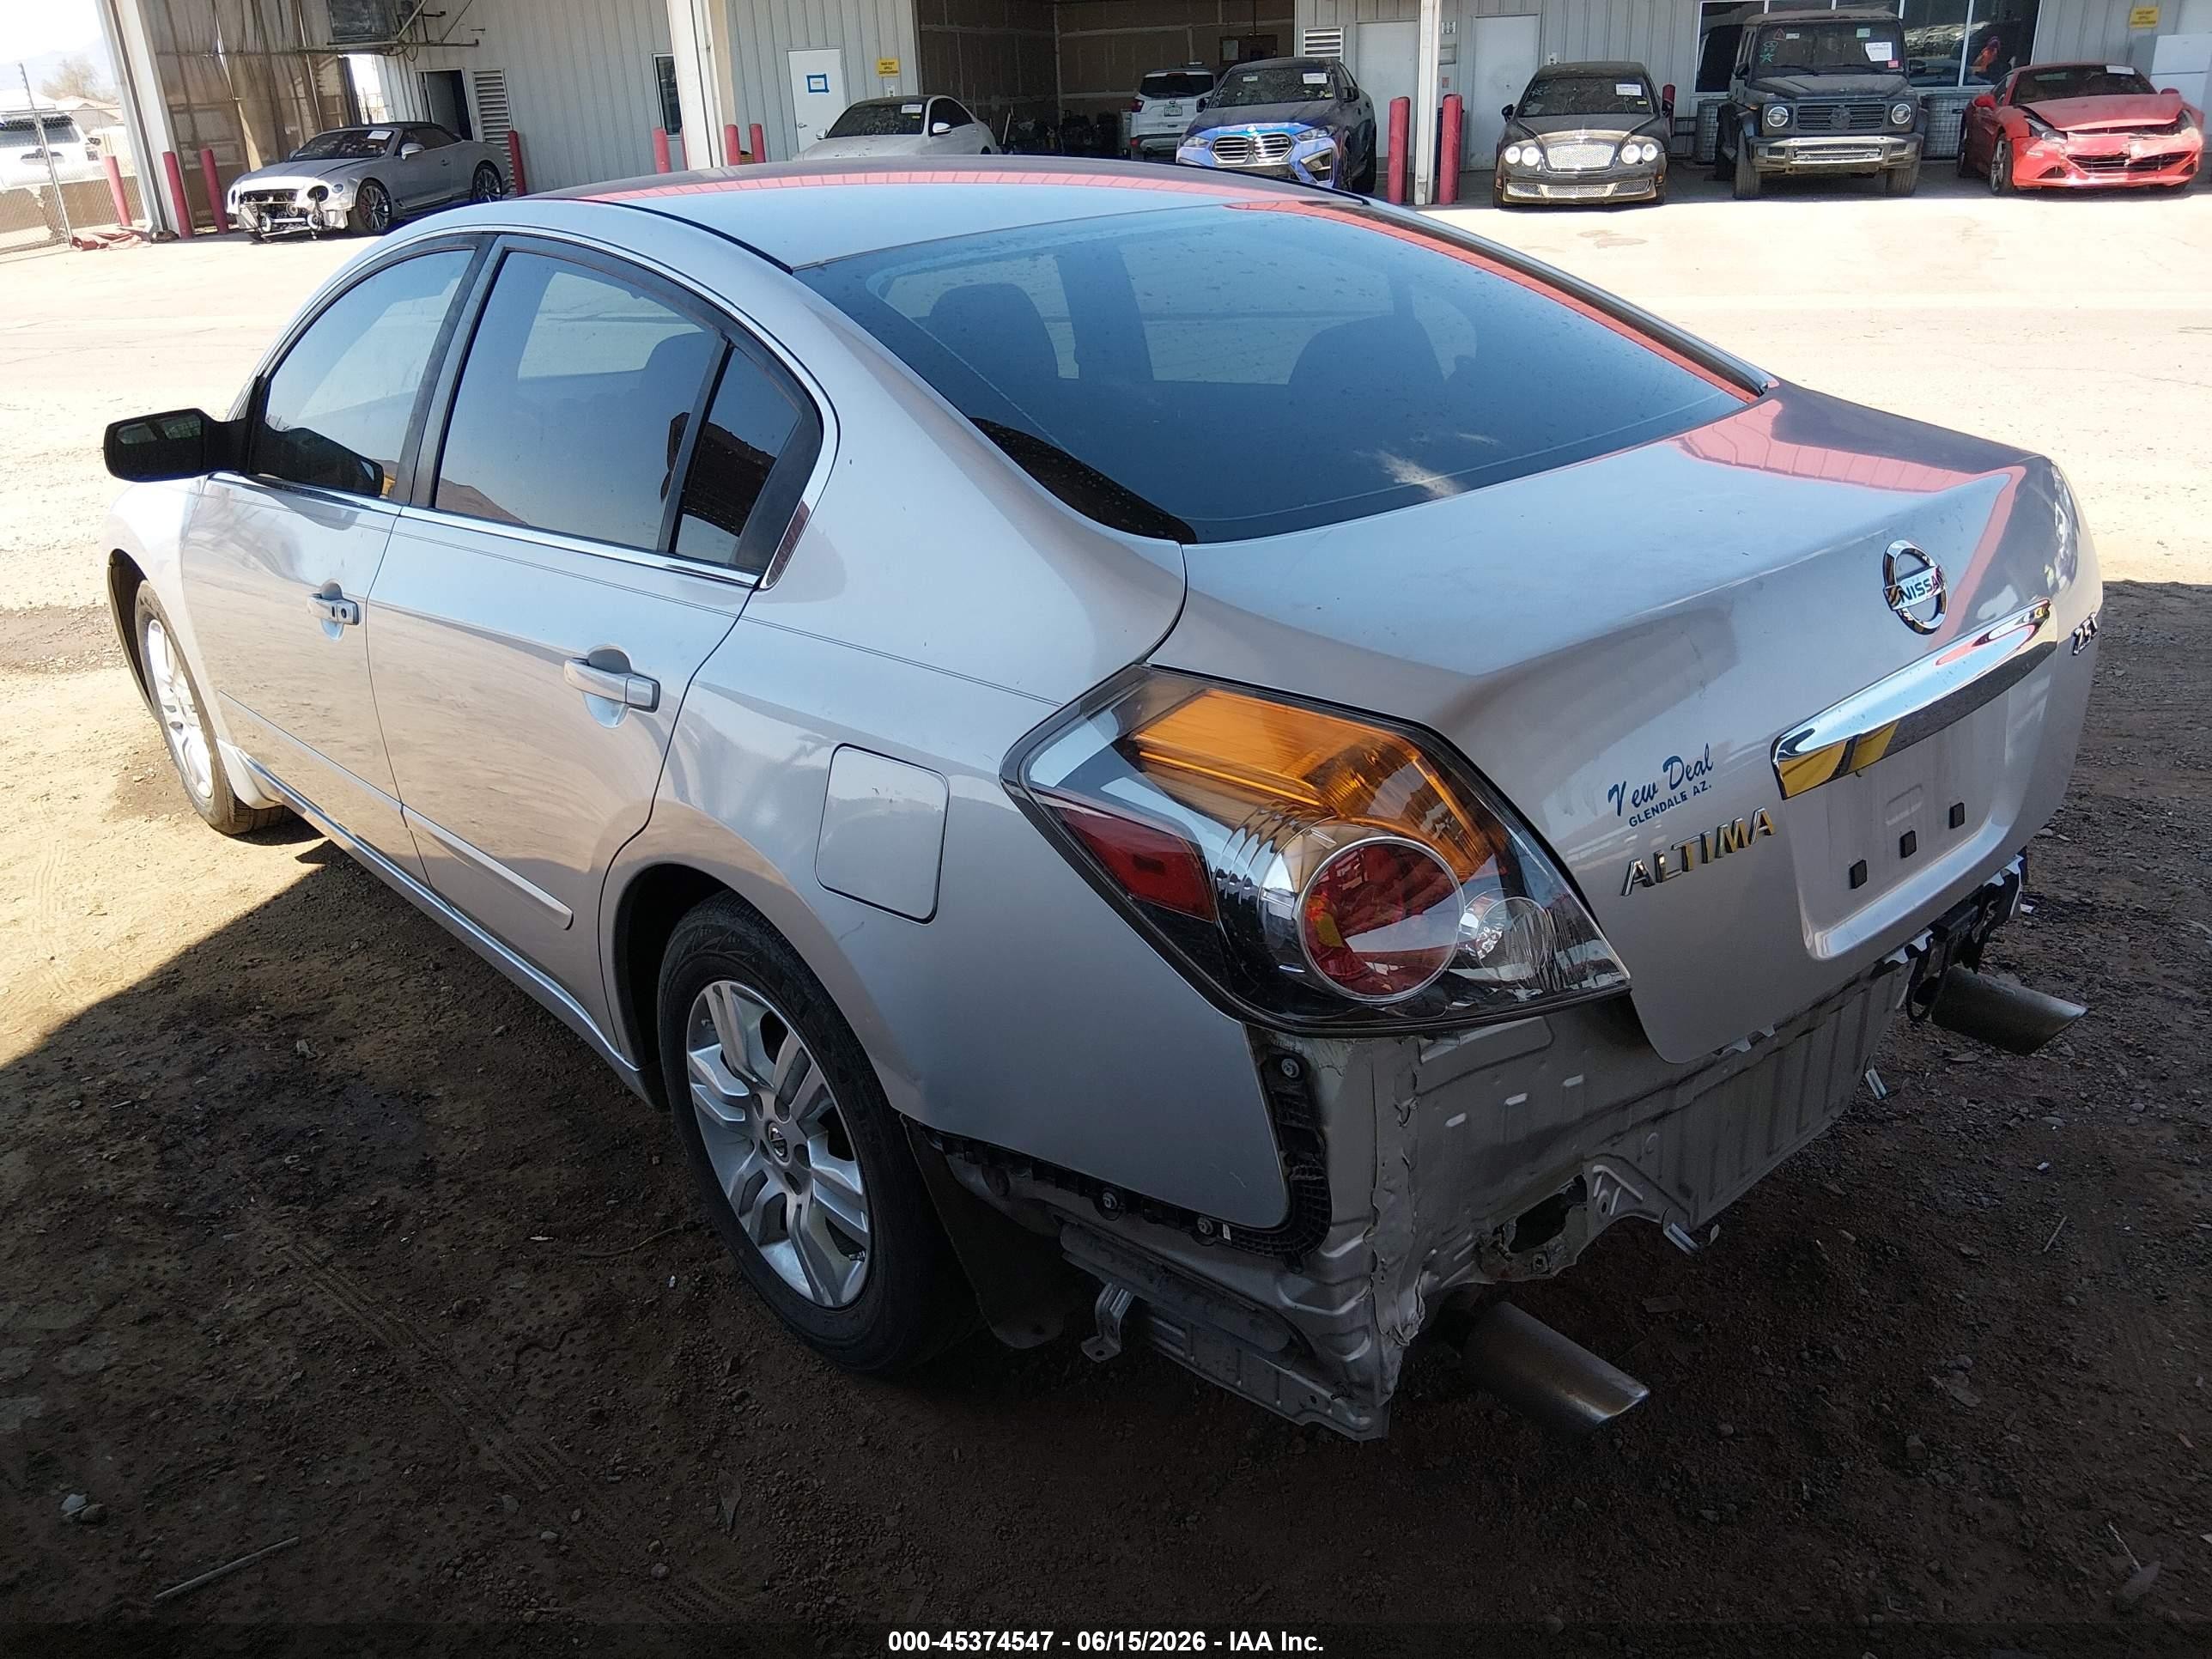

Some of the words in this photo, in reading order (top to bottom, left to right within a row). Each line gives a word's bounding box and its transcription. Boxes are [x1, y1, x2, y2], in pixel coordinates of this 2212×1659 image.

[1898, 565, 1944, 603] NISSAN
[1662, 743, 1713, 789] Deal
[1628, 790, 1688, 828] GLENDALE
[1692, 780, 1712, 796] AZ.
[1620, 806, 1776, 896] ALTIMA
